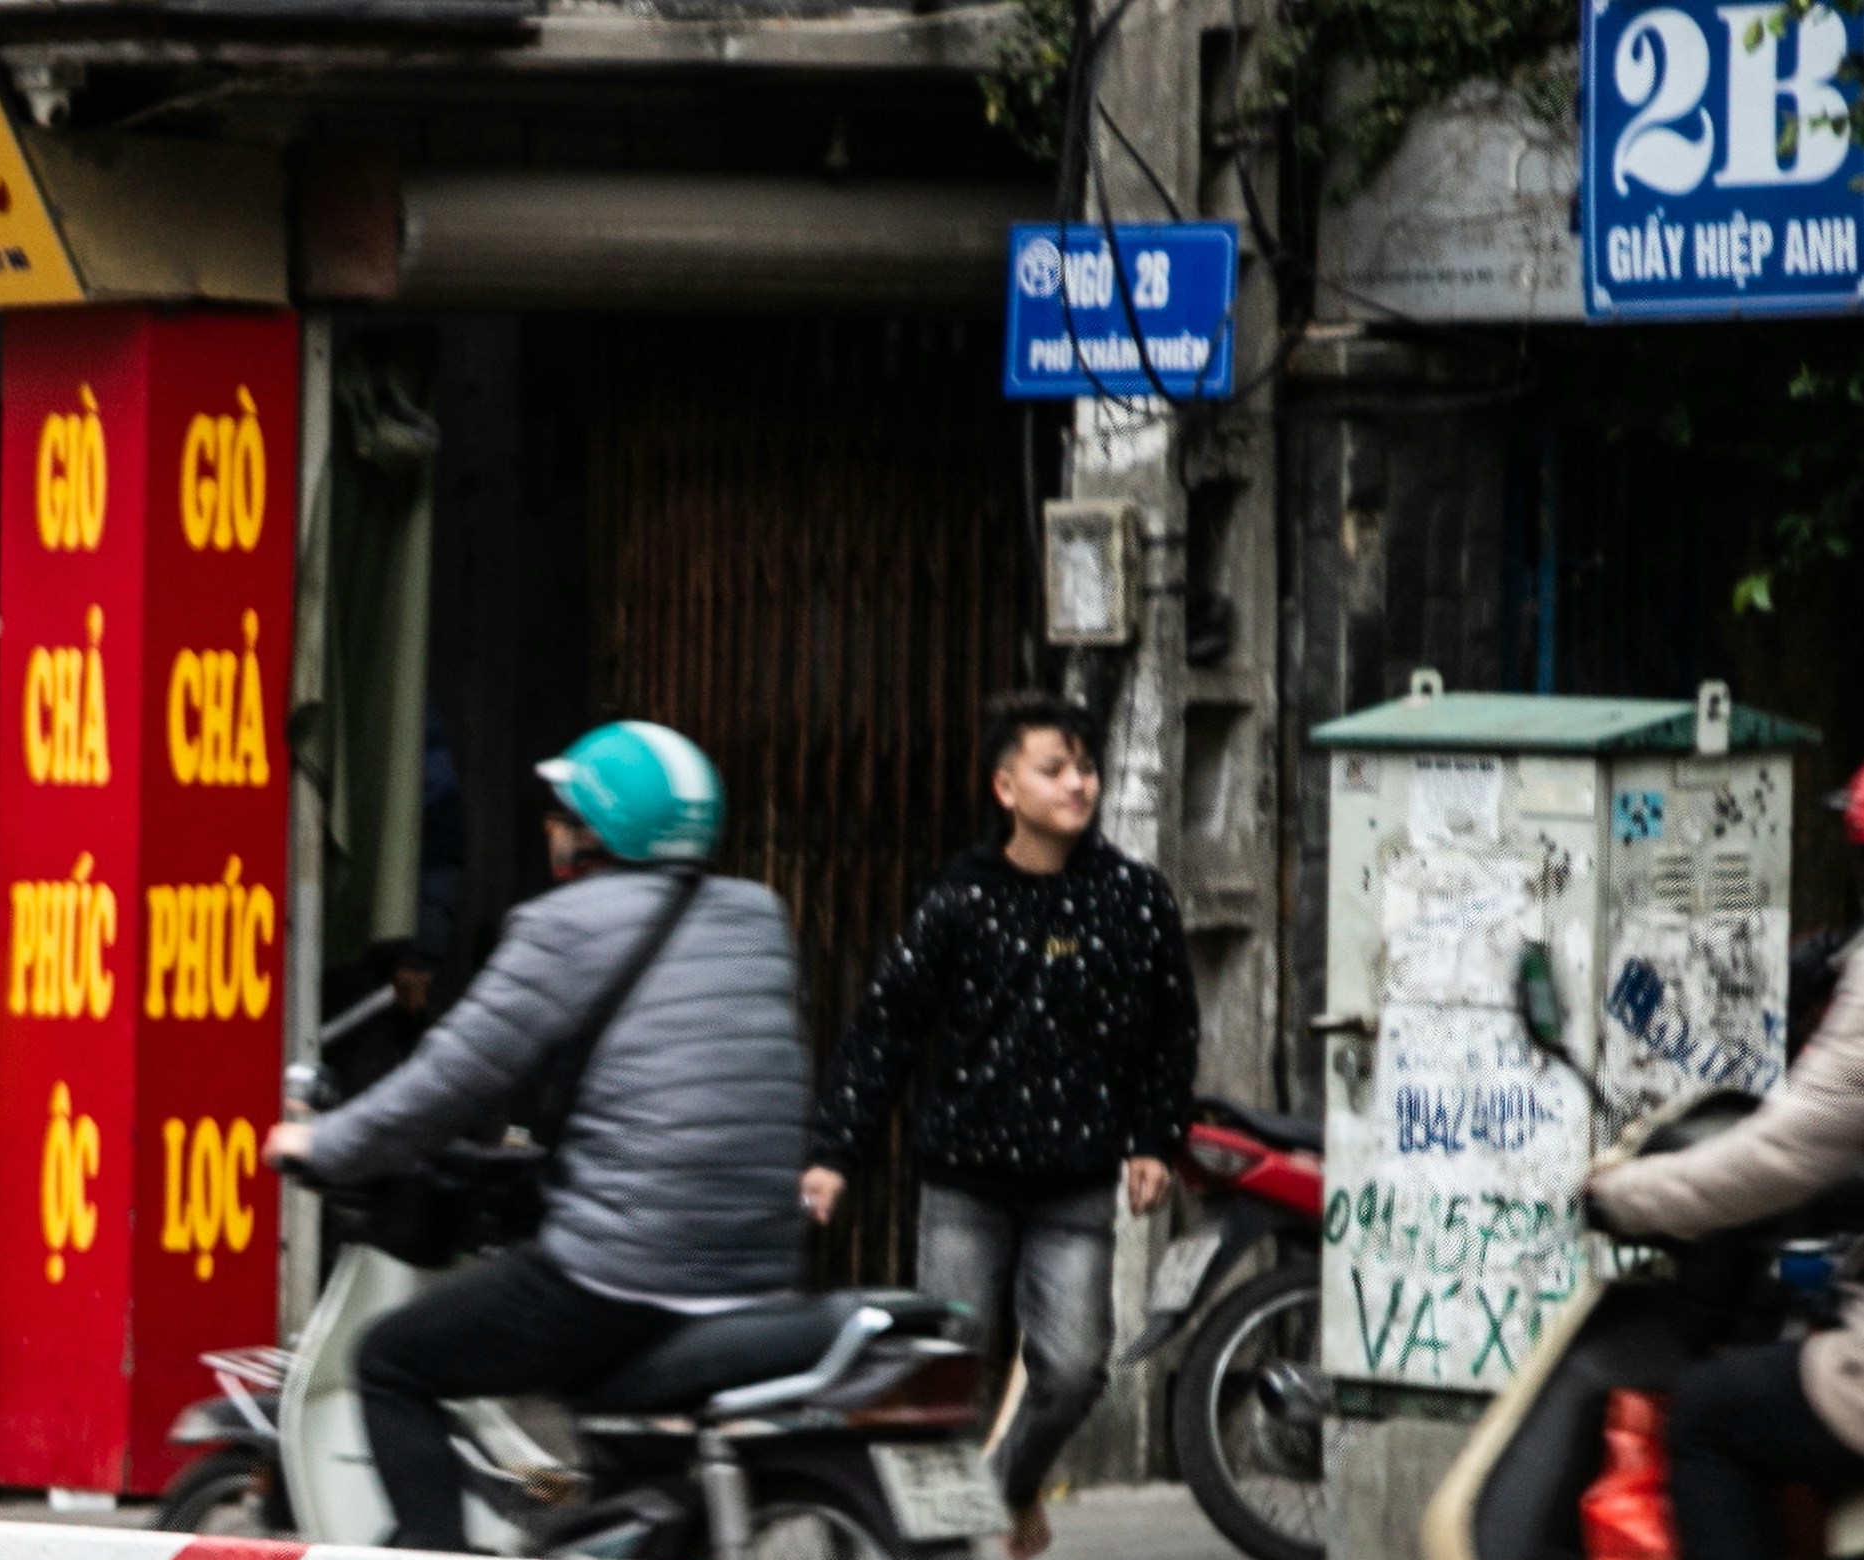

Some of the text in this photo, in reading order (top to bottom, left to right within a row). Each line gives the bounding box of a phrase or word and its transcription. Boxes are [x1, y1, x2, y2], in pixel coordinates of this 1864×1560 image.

[1612, 4, 1853, 197] 2B
[1692, 208, 1774, 290] HIỆP
[1783, 216, 1859, 277] ANH
[35, 381, 108, 552] GIÒ
[180, 384, 267, 552] GIÒ
[22, 603, 111, 786] CHẢ
[167, 608, 270, 788] CHẢ
[7, 851, 118, 1019] PHÚC
[145, 855, 275, 1019] PHÚC
